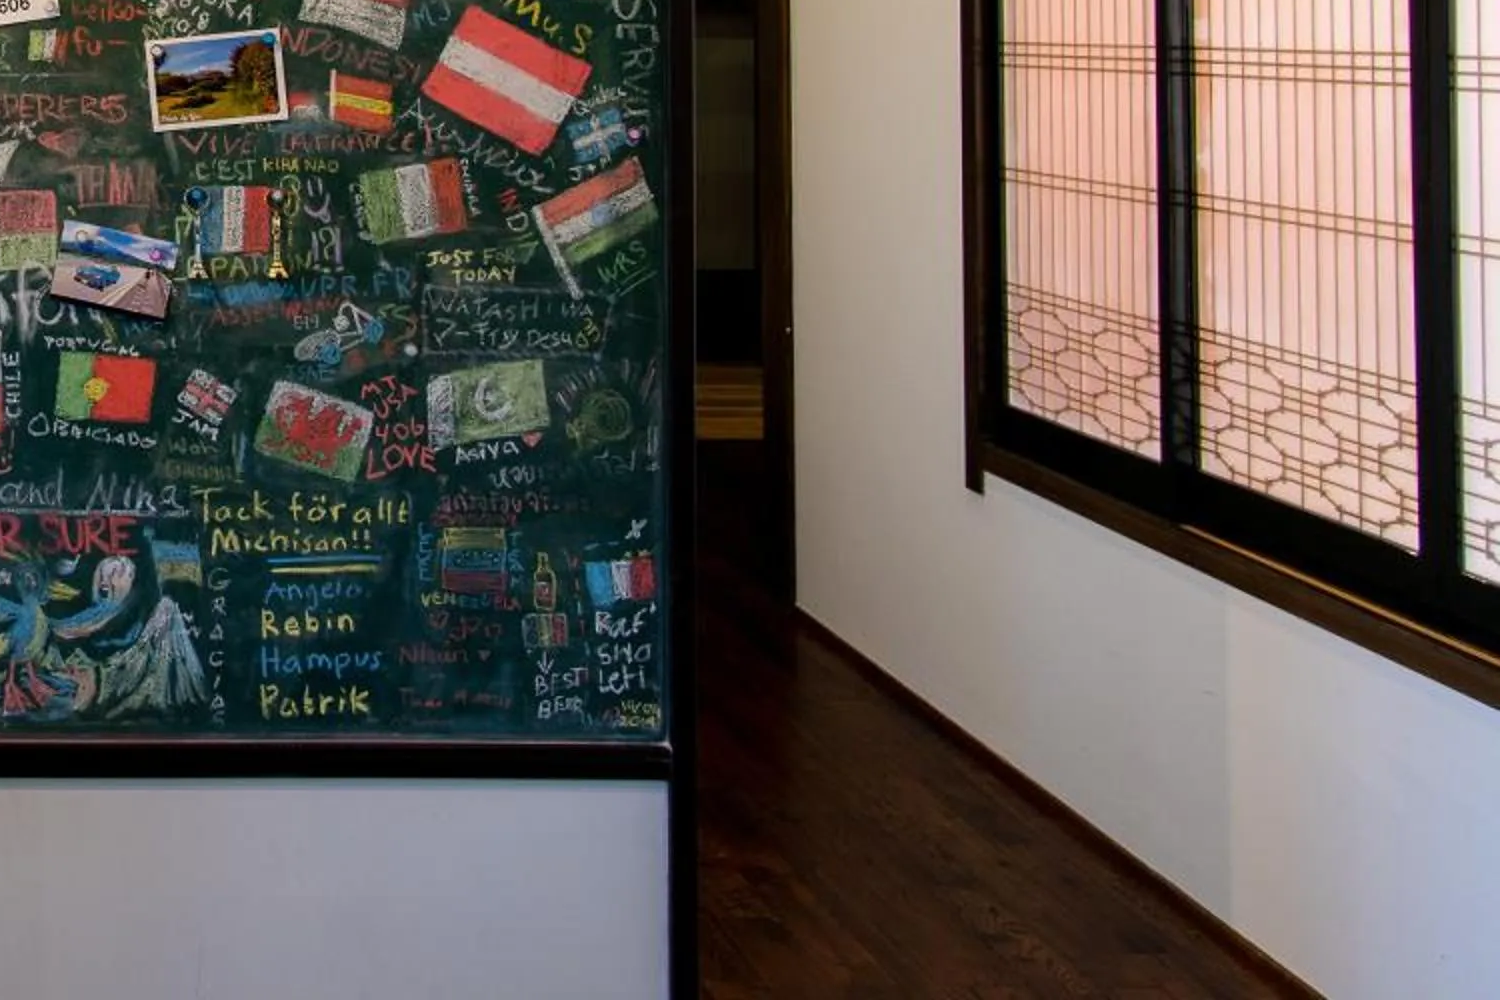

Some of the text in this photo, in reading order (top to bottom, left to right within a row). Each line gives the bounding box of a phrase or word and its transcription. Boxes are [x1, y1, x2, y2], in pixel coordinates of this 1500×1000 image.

[2, 350, 22, 420] CHILE
[366, 443, 438, 481] LOVE
[191, 486, 275, 524] Tack
[288, 491, 347, 522] för
[259, 683, 371, 721] Patrik
